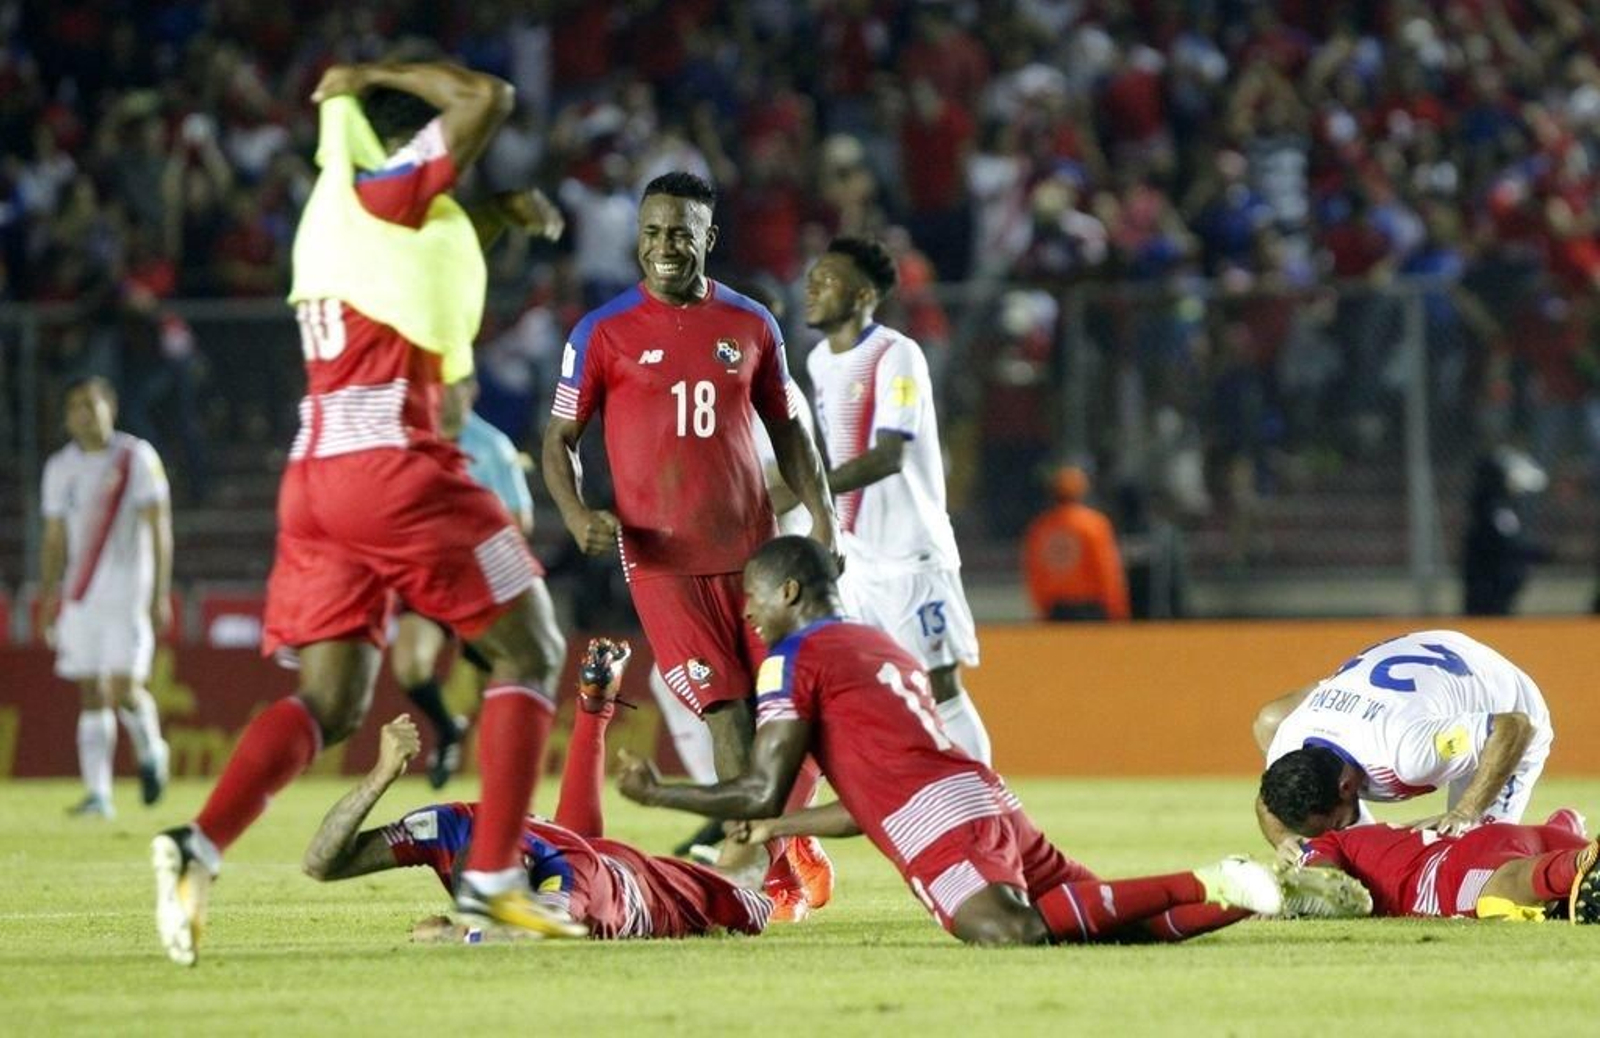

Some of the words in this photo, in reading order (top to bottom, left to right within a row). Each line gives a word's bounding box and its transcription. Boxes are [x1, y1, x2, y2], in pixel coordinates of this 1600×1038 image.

[671, 380, 716, 438] 18
[917, 601, 946, 637] 13
[1361, 698, 1387, 723] M.
